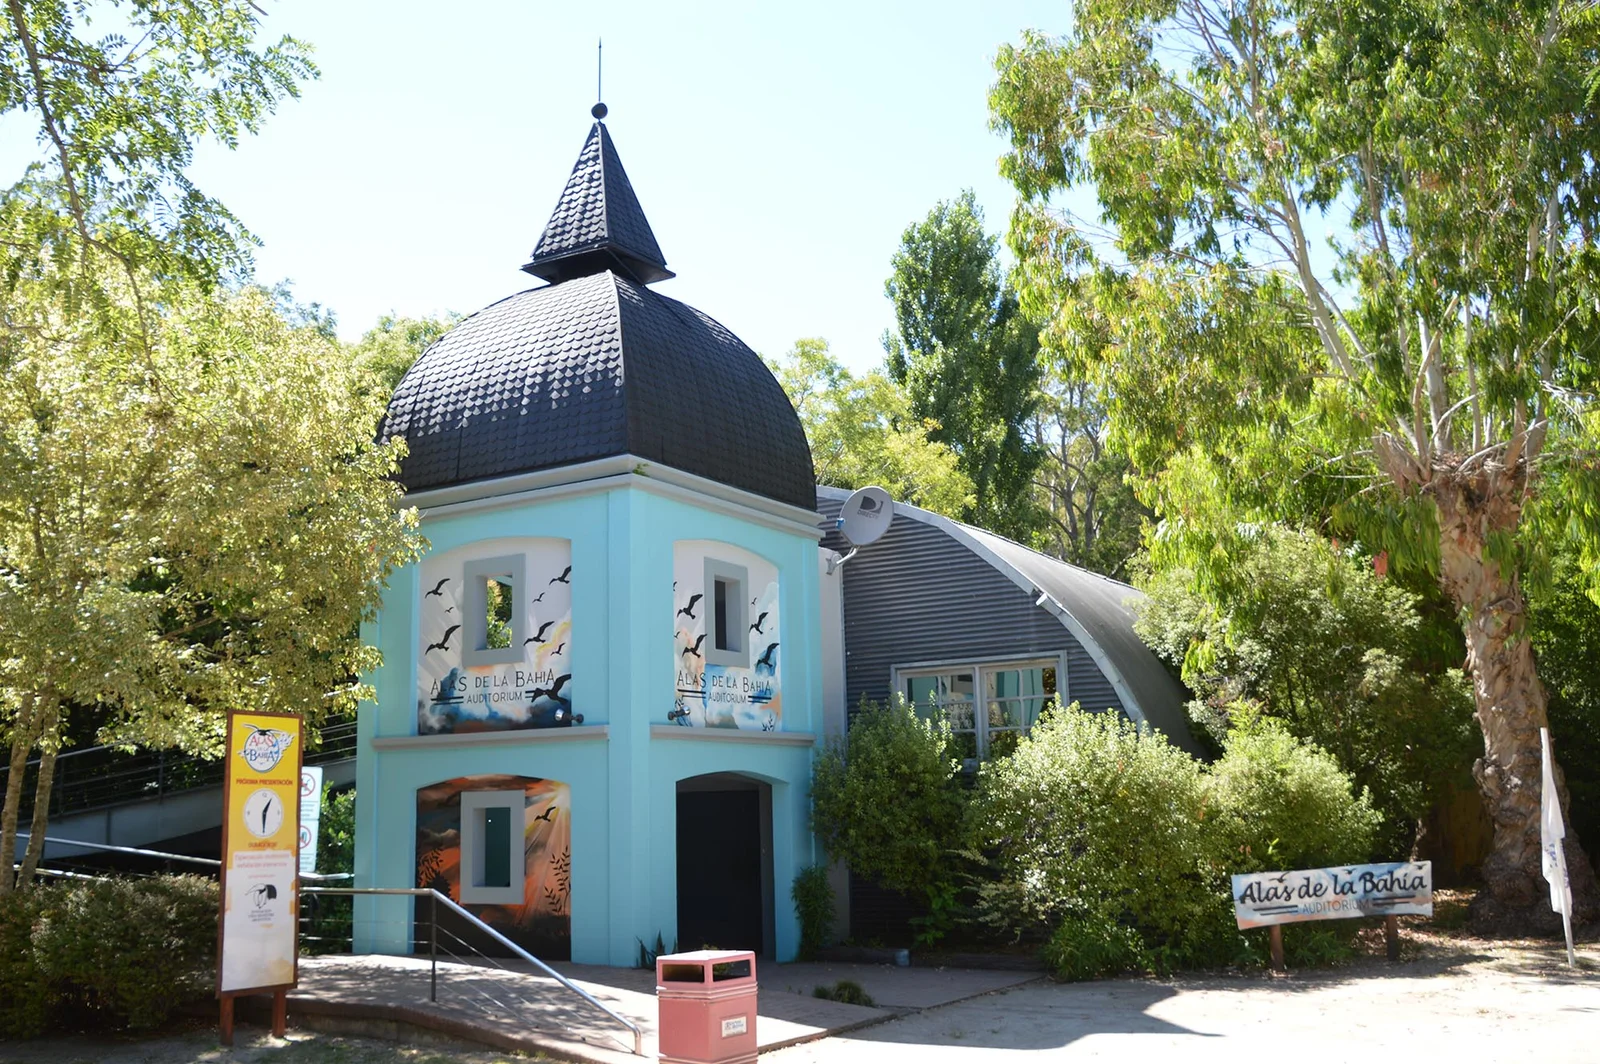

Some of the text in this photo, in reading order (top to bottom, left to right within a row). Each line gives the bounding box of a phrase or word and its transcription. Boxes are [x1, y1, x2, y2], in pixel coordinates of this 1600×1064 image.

[430, 676, 467, 695] ALAS
[475, 676, 489, 688] DE
[494, 675, 509, 687] LA
[677, 670, 706, 689] ALAS
[712, 675, 723, 688] DE
[726, 676, 738, 689] LA
[467, 691, 523, 704] AUDITORIUM
[708, 692, 748, 704] AUDITORIUM
[1239, 870, 1427, 904] Alas de la Bahía
[1302, 899, 1371, 914] AUDITORIUM
